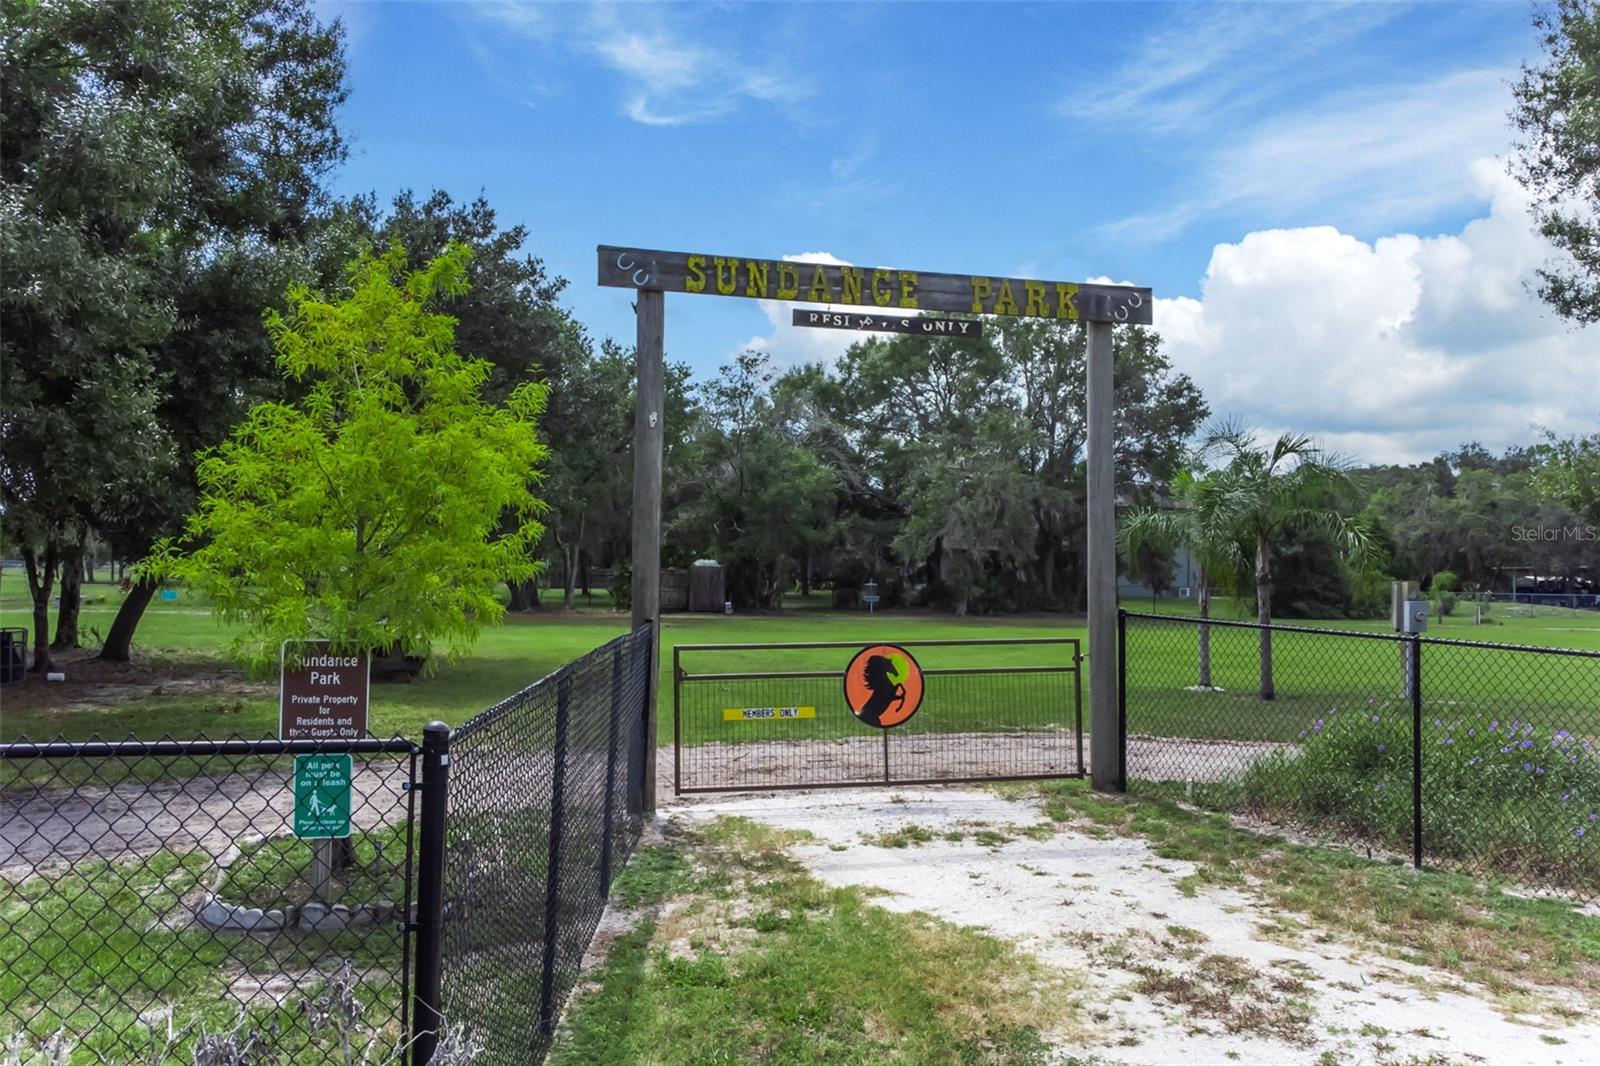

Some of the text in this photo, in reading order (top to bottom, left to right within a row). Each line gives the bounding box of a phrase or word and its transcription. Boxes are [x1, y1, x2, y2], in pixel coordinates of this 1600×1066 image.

[685, 253, 1081, 320] SUNDANCE PARK
[293, 653, 359, 667] Sundance
[310, 671, 341, 685] Park
[291, 694, 359, 706] Private Property
[319, 705, 331, 715] for
[744, 707, 799, 719] MEMBERS ONLY
[296, 716, 353, 726] Residents and
[339, 727, 359, 738] Only
[322, 778, 346, 786] leash
